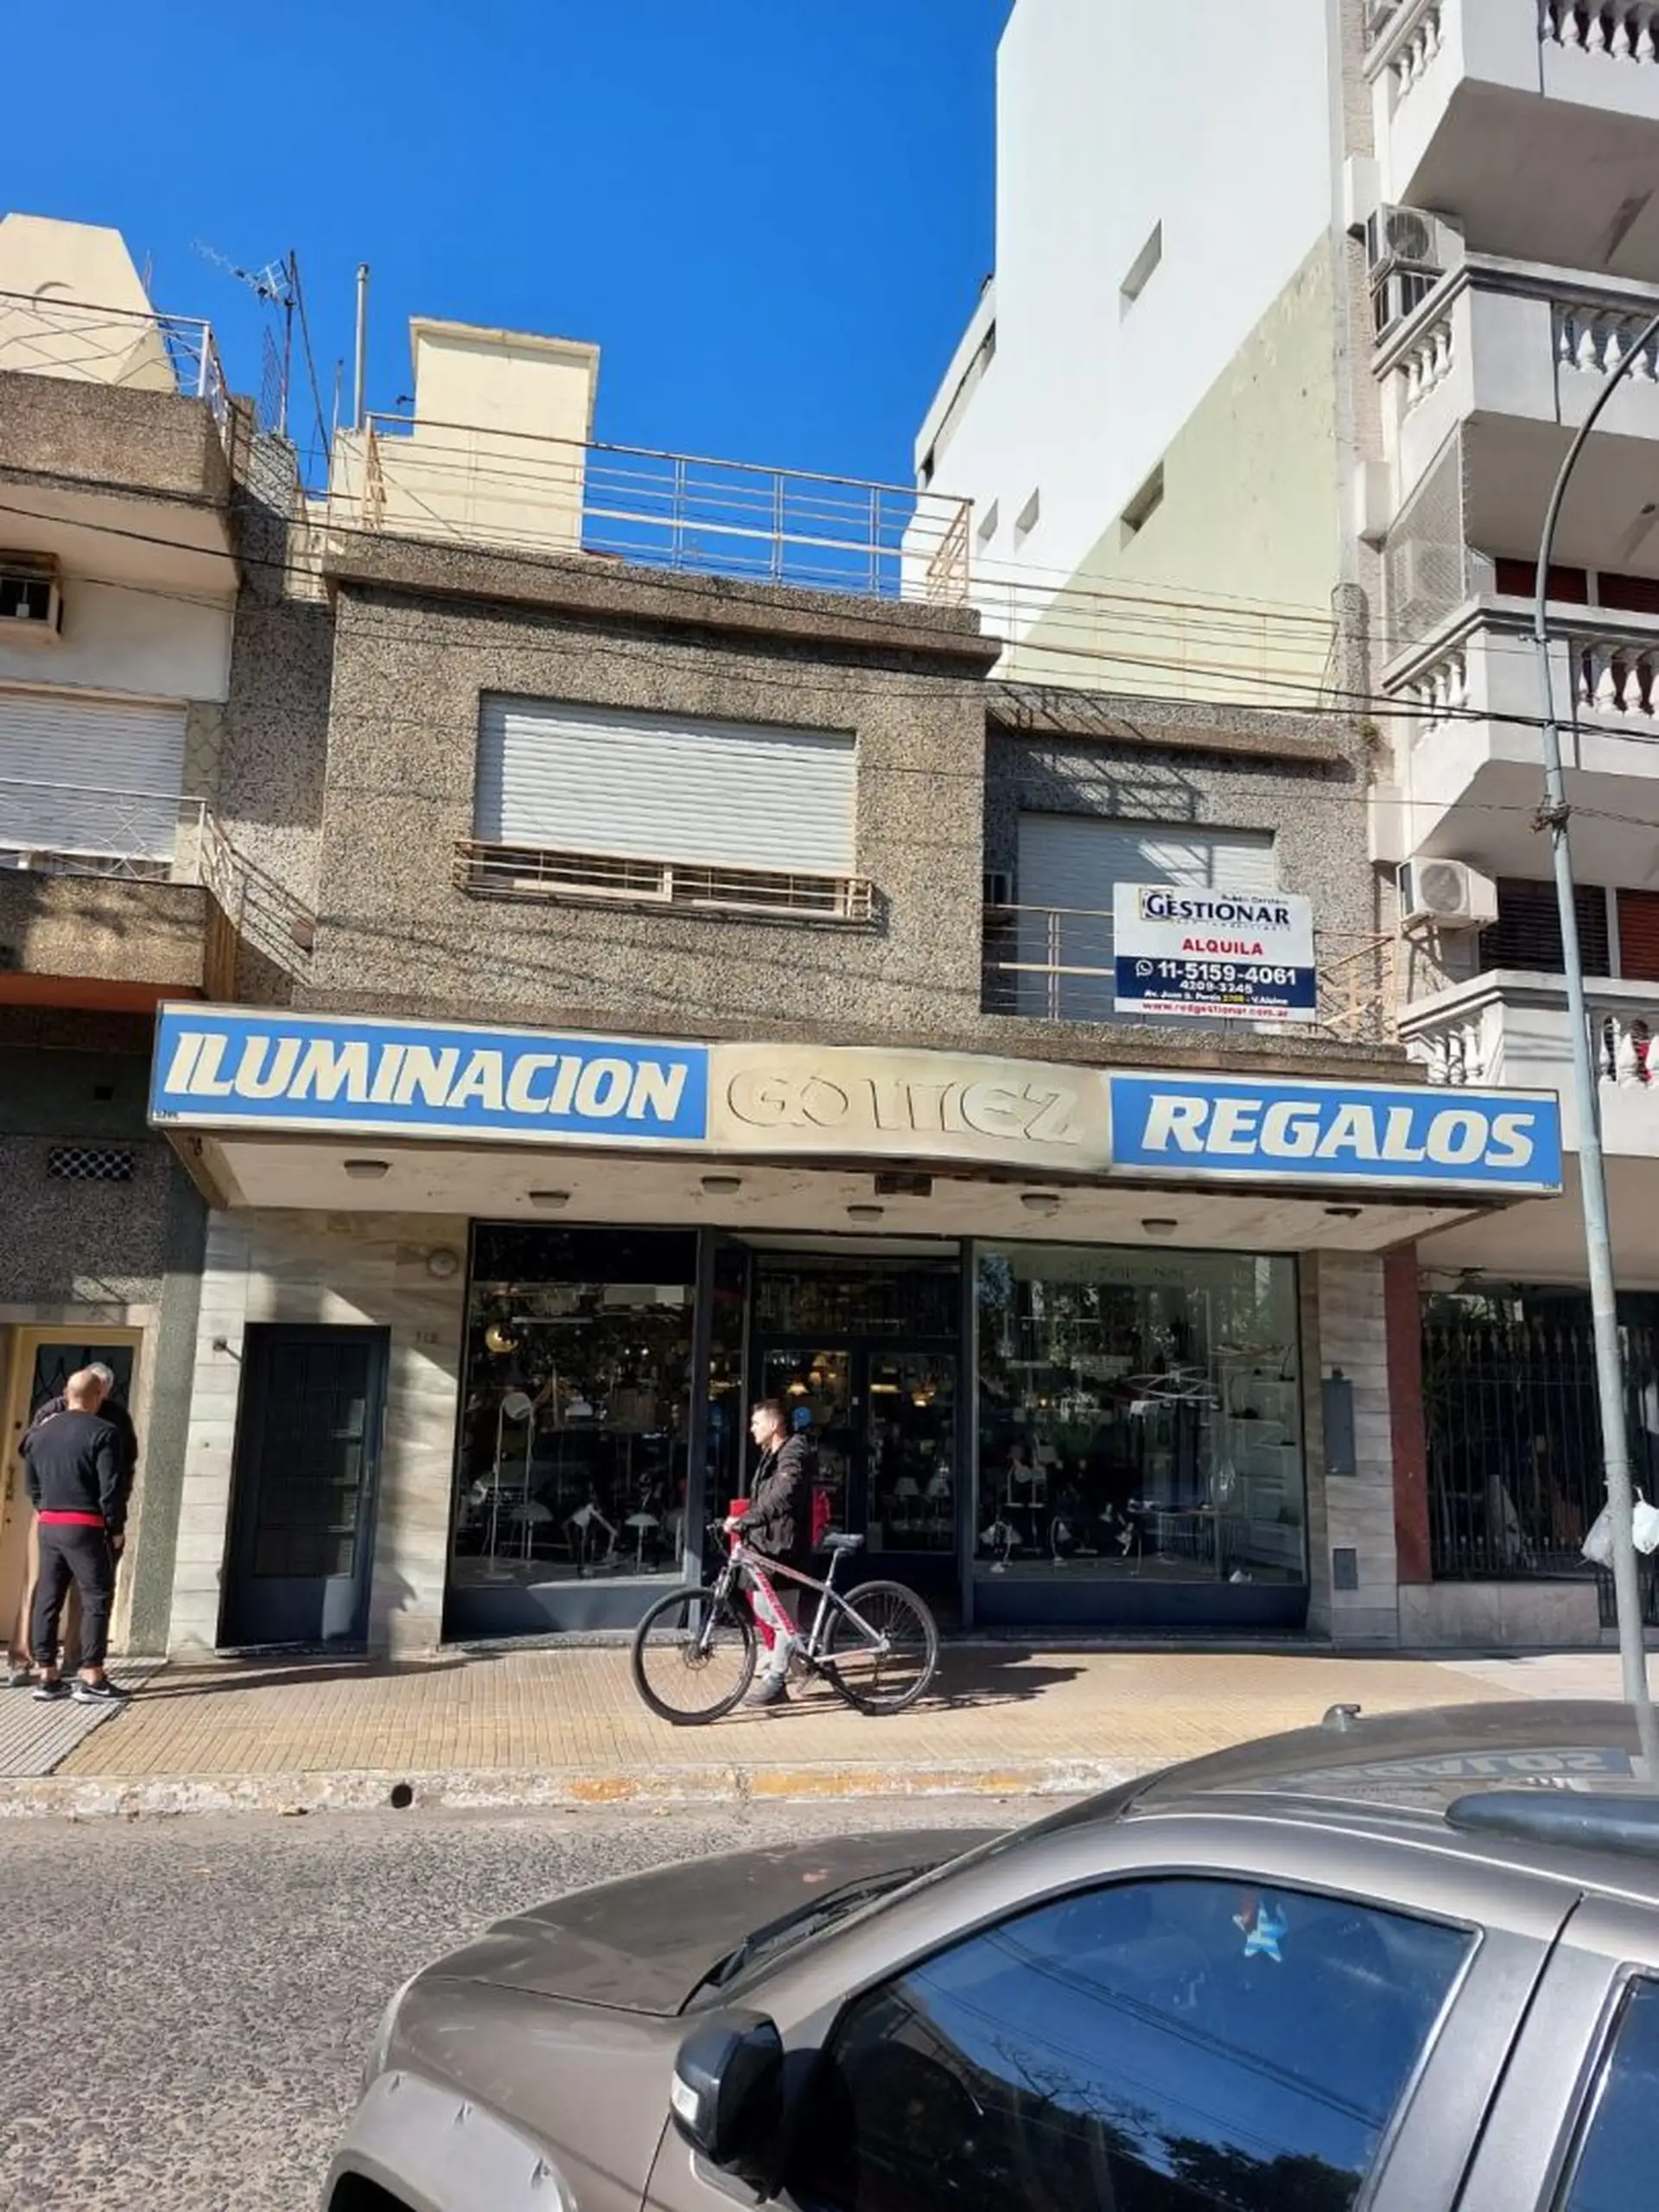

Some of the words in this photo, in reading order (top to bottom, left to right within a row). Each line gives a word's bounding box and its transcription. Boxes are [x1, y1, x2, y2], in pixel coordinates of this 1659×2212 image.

[1147, 893, 1290, 925] GESTIONAR
[1182, 938, 1264, 956] ALQUILA
[1158, 960, 1296, 986] 11-5159-4061
[164, 1031, 688, 1122] ILUMINACION
[1141, 1095, 1535, 1167] REGALOS
